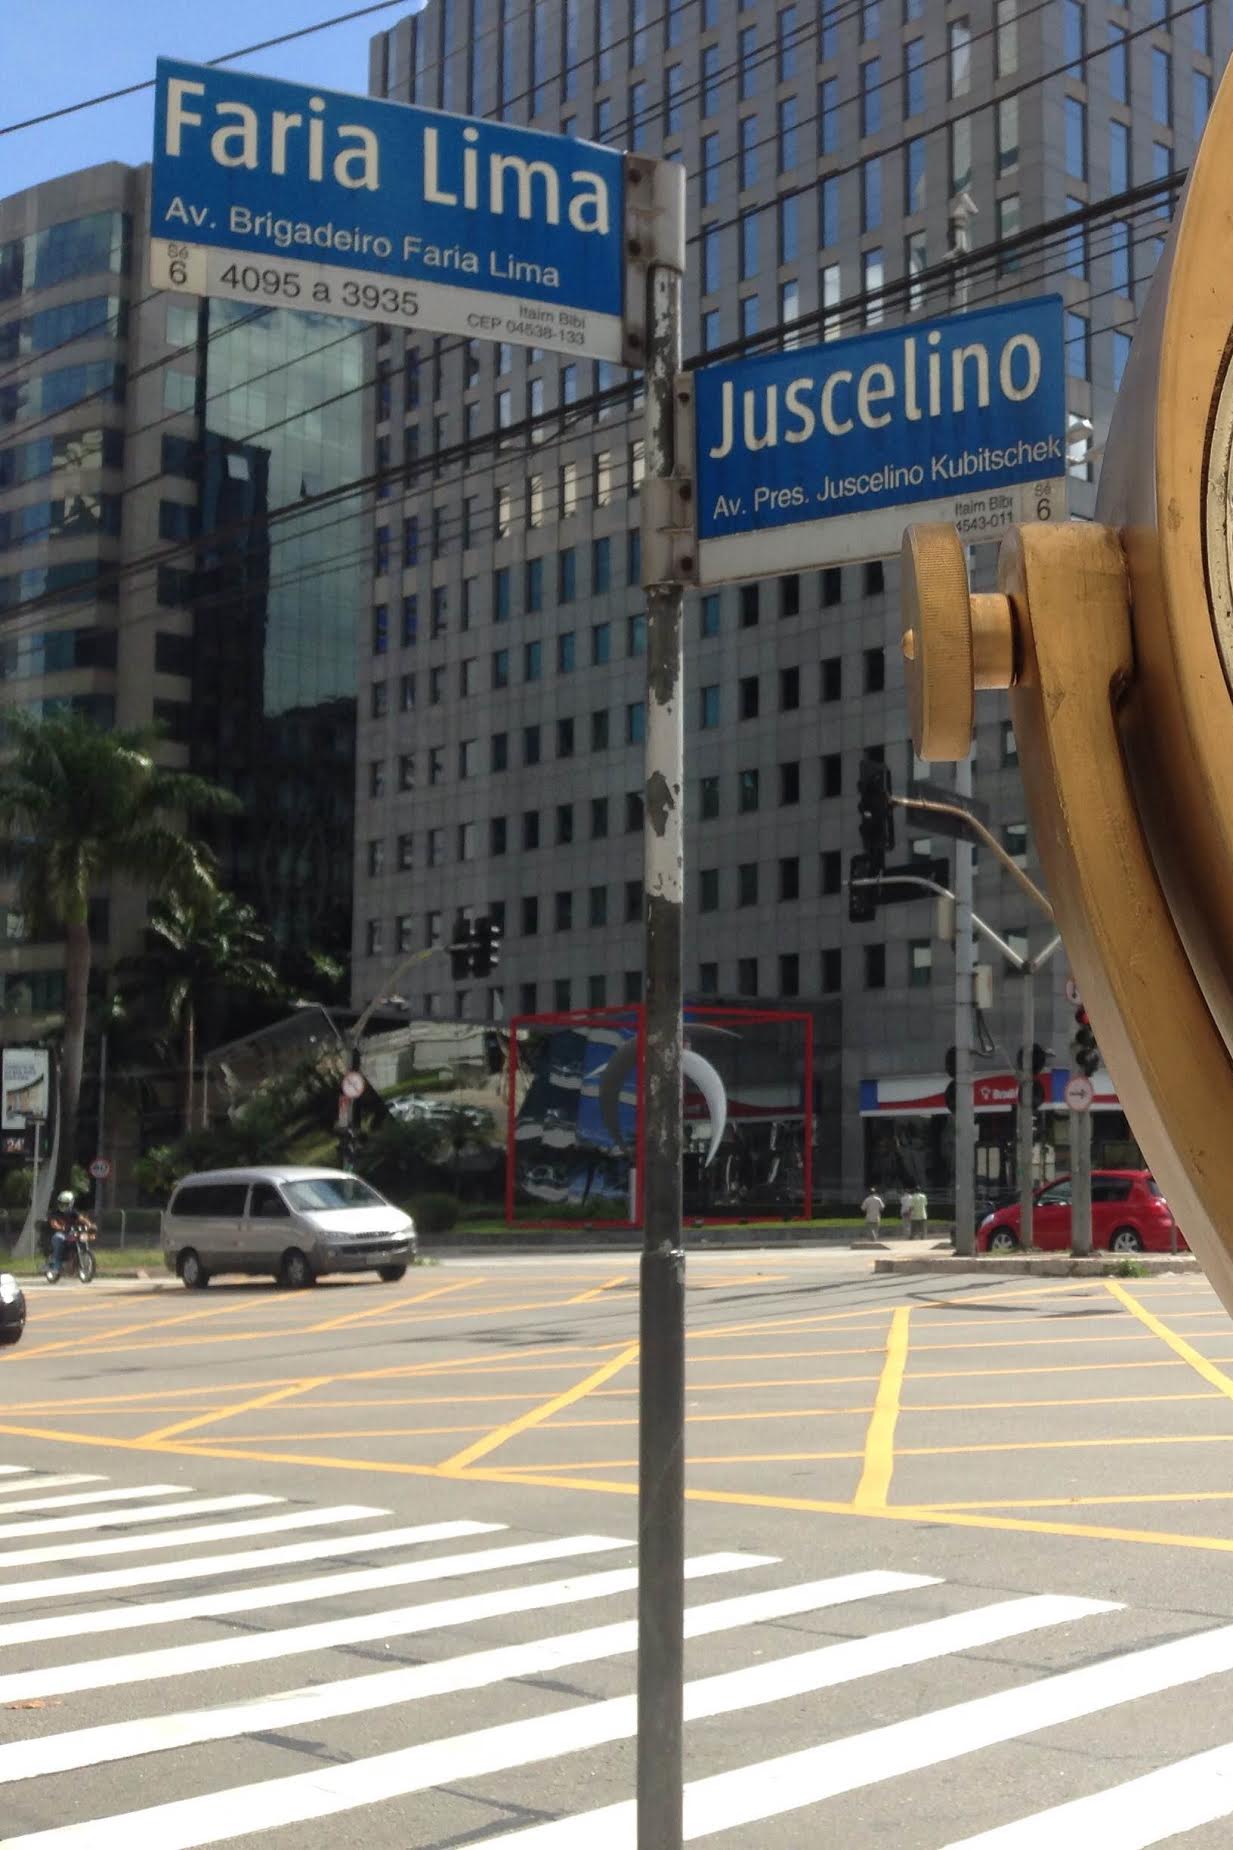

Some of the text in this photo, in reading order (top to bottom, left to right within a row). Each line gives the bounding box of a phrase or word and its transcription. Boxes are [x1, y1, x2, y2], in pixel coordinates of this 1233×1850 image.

[164, 77, 611, 236] Faria Lima
[164, 197, 561, 288] Av. Brigadeiro Faria Lima
[169, 259, 188, 286] 6
[220, 263, 419, 317] 4095 a 3935
[466, 312, 502, 330] CEP
[518, 304, 586, 330] Itaim Bibi
[709, 329, 1042, 459] Juscelino
[712, 433, 1062, 520] Av. Pres. Juscelino Kubitschek
[955, 498, 986, 516] Itaim
[1037, 498, 1052, 522] 6
